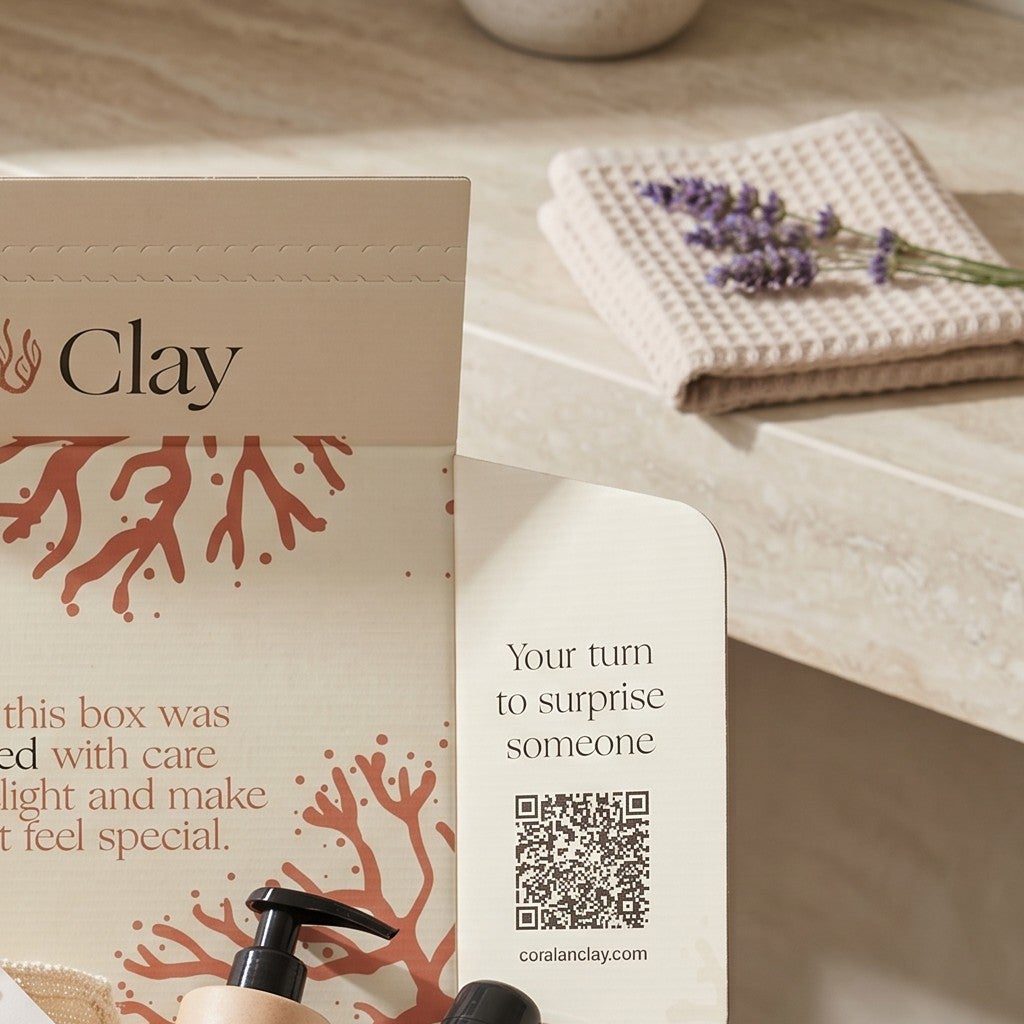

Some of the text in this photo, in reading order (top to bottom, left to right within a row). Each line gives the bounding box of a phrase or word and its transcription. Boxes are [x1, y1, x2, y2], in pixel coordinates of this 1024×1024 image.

[60, 319, 243, 412] Clay
[507, 643, 653, 671] Your turn
[4, 696, 66, 729] this
[79, 696, 146, 729] box
[157, 705, 230, 729] was
[496, 683, 665, 721] to surprise
[50, 737, 129, 770] with
[142, 746, 219, 770] care
[507, 733, 656, 760] someone
[88, 777, 155, 811] and
[168, 776, 269, 811] make
[23, 819, 84, 852] feel
[98, 817, 230, 861] special.
[519, 946, 648, 966] coralanclay.com
